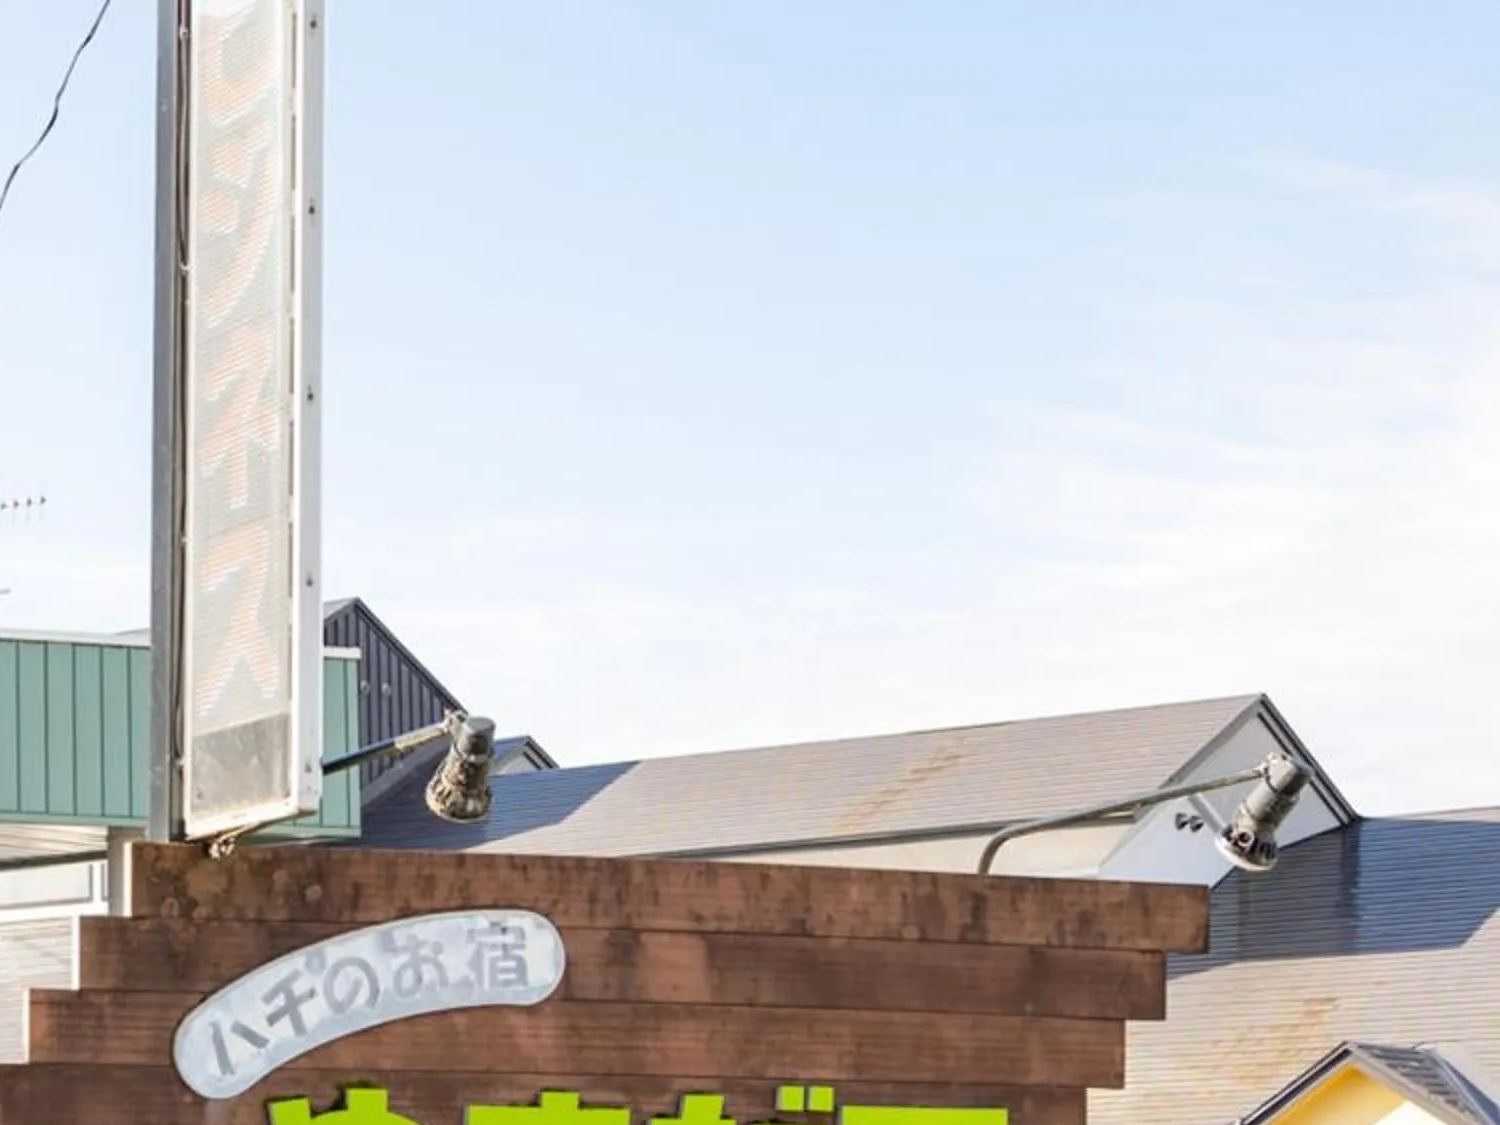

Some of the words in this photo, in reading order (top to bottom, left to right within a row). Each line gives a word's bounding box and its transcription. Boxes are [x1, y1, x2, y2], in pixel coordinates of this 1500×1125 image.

[209, 920, 530, 1078] ハチのお宿
